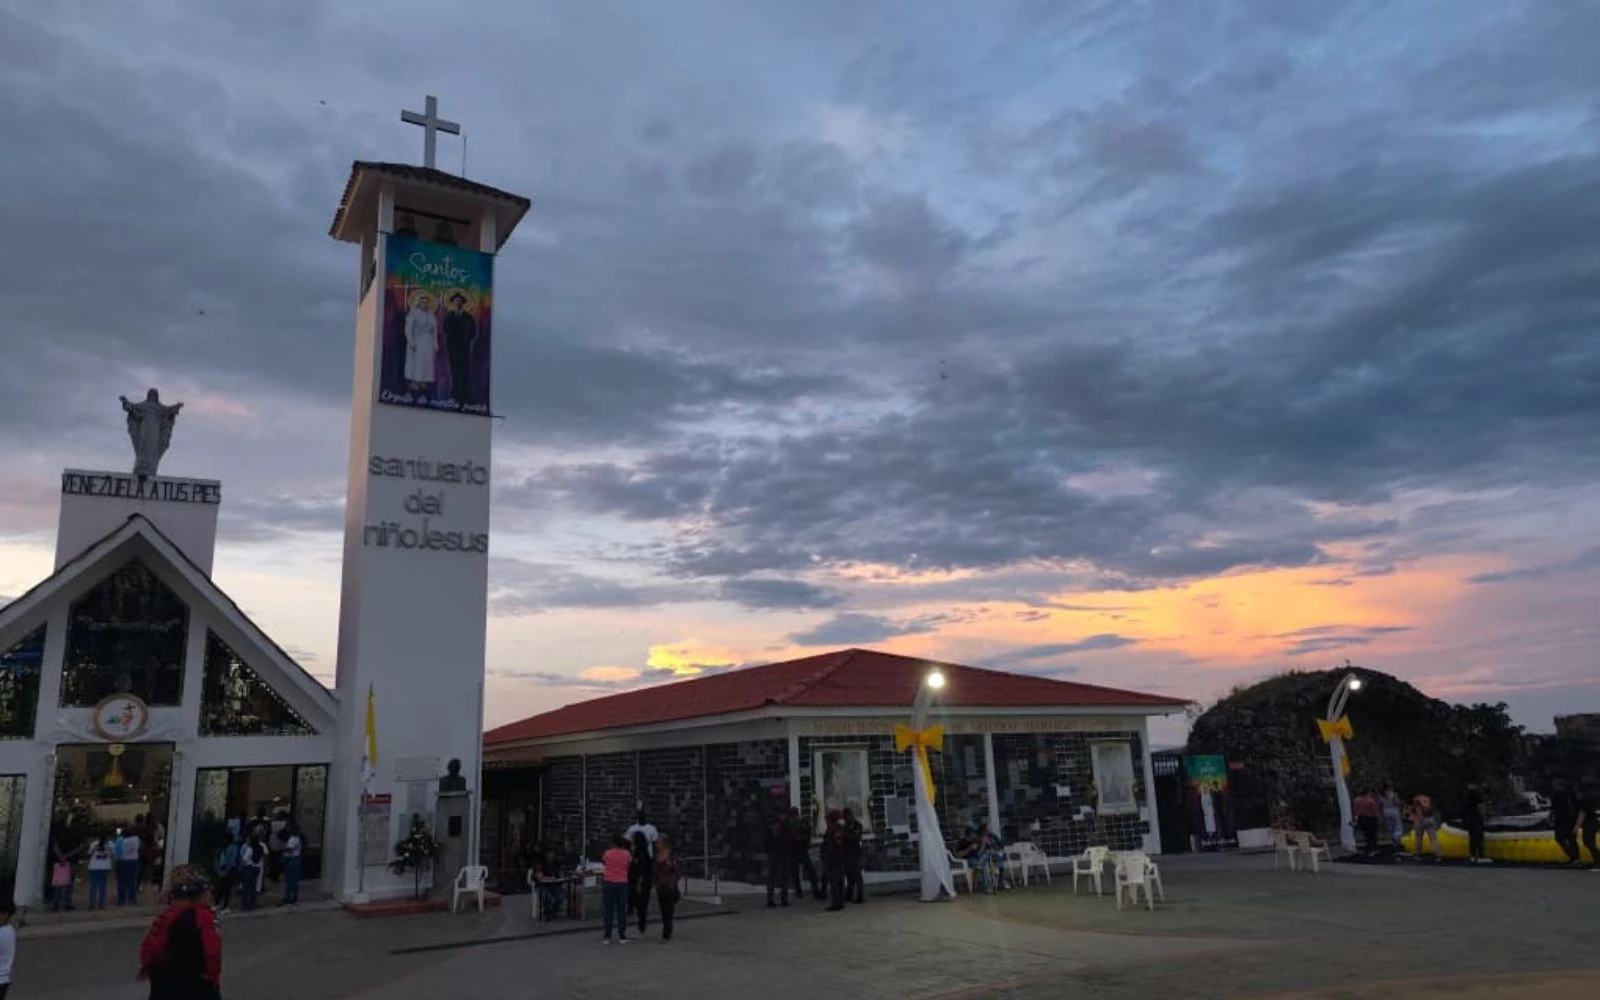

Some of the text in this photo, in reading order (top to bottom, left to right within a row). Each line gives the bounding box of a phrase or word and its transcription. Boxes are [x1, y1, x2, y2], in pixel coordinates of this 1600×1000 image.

[409, 252, 472, 283] Santos
[369, 455, 488, 485] santuario
[403, 487, 444, 515] del
